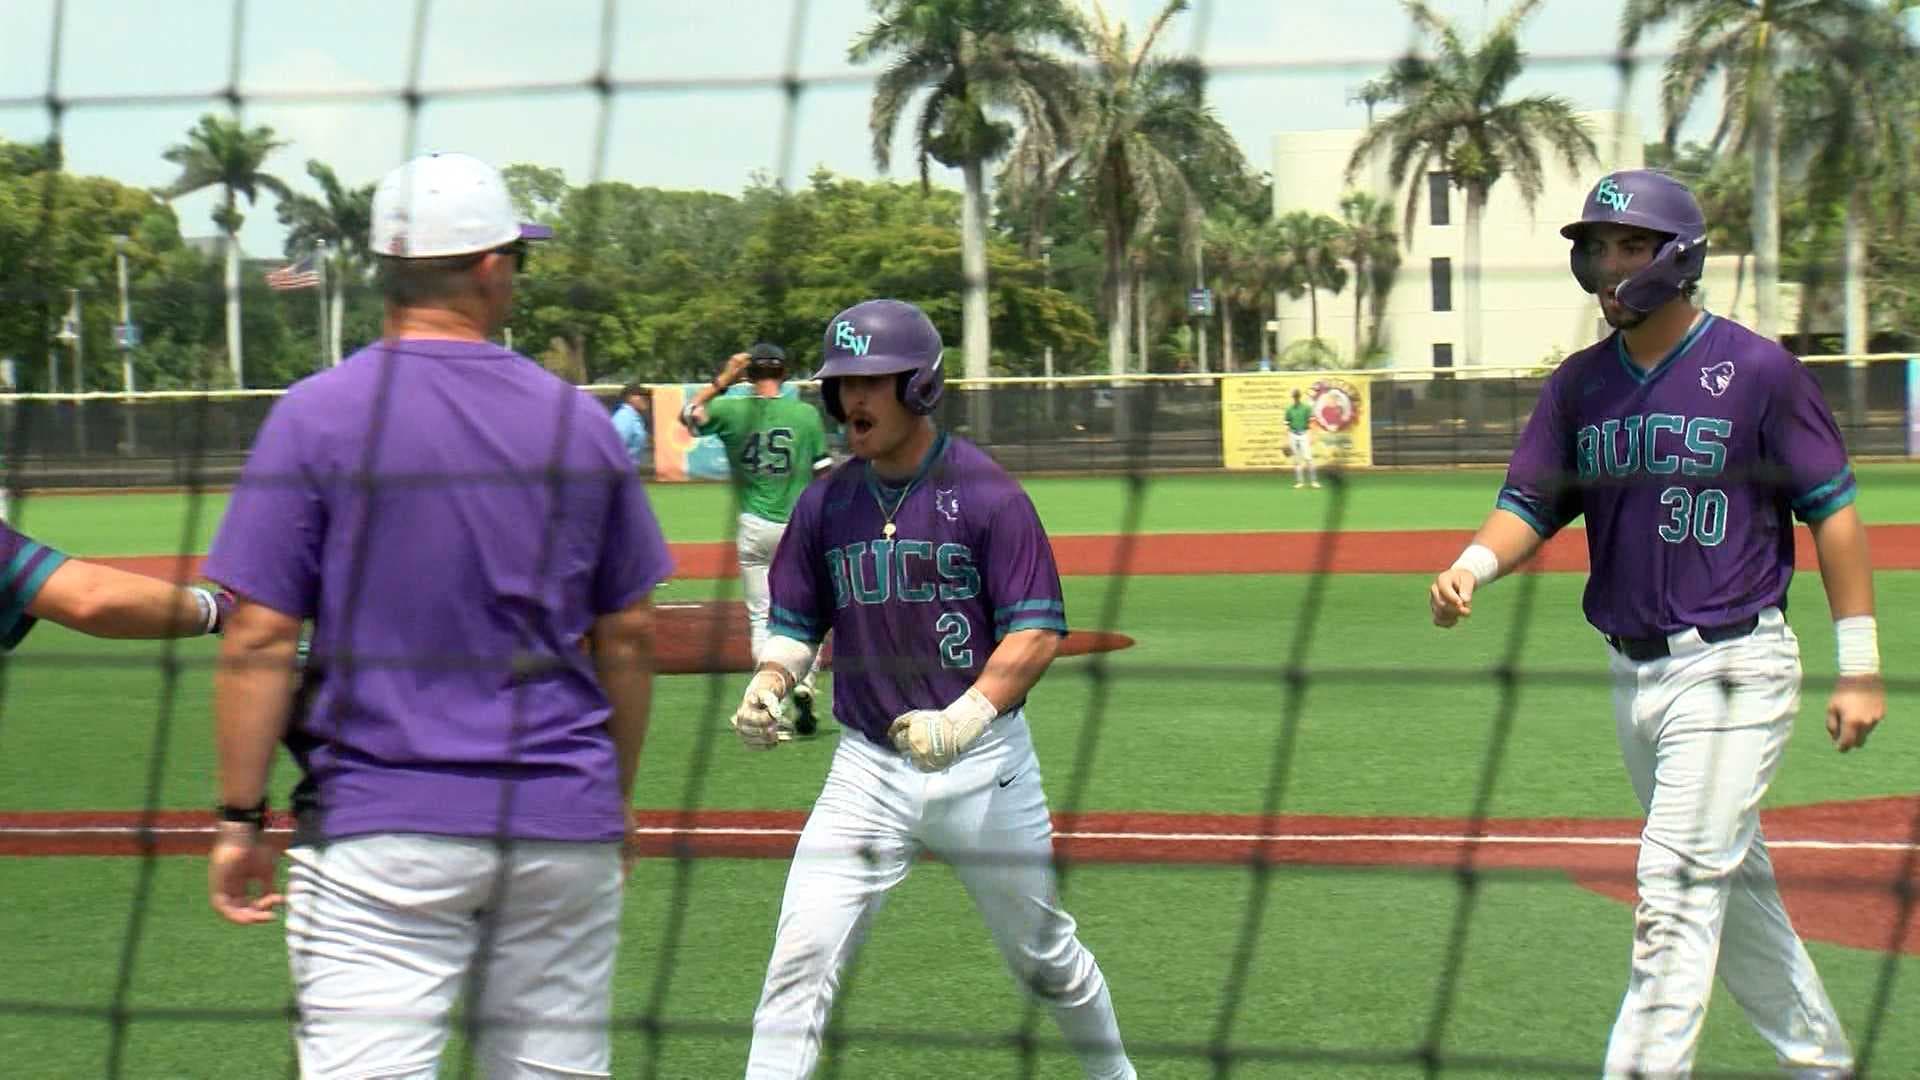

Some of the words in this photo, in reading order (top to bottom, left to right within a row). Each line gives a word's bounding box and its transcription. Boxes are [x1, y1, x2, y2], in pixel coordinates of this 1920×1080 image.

[834, 320, 872, 356] FSW
[740, 426, 793, 474] 45
[1577, 413, 1733, 480] BUCS
[1658, 486, 1729, 546] 30
[935, 611, 973, 668] 2
